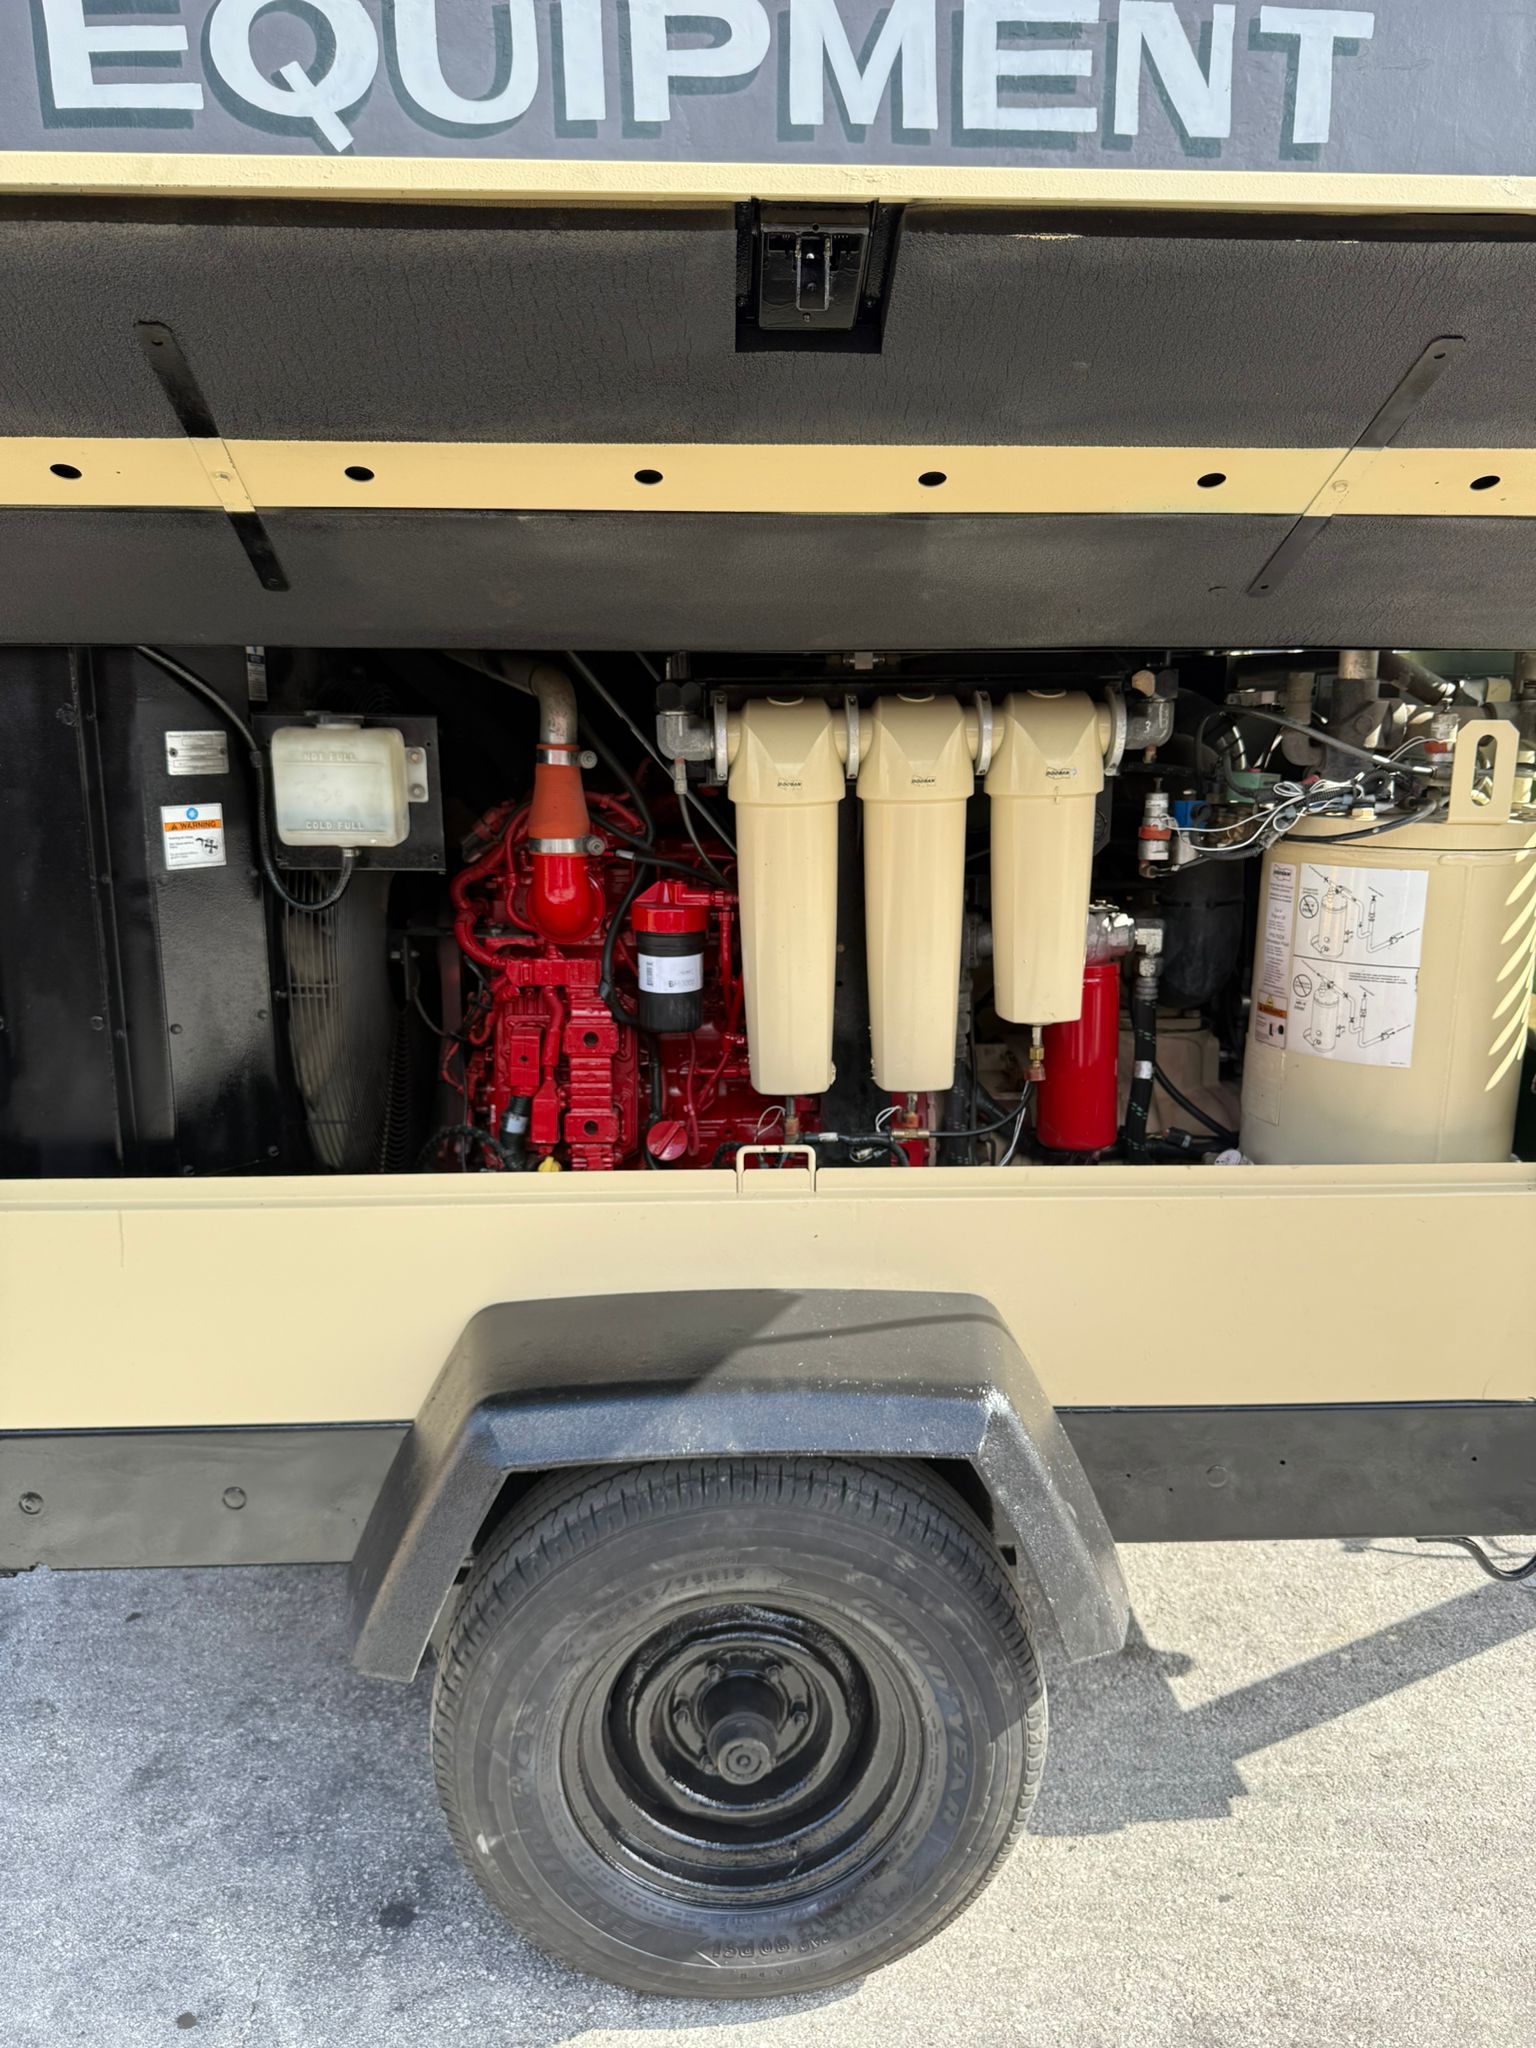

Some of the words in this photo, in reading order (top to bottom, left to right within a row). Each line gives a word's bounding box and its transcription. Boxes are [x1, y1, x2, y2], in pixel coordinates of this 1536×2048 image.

[36, 0, 1375, 154] EQUIPMENT
[329, 751, 357, 761] FULL
[180, 820, 217, 830] WARNING
[304, 820, 332, 831] COLD
[337, 820, 365, 831] FULL
[849, 1595, 968, 1828] GOODYEAR
[712, 1938, 753, 1959] PSI
[758, 1935, 792, 1957] 80
